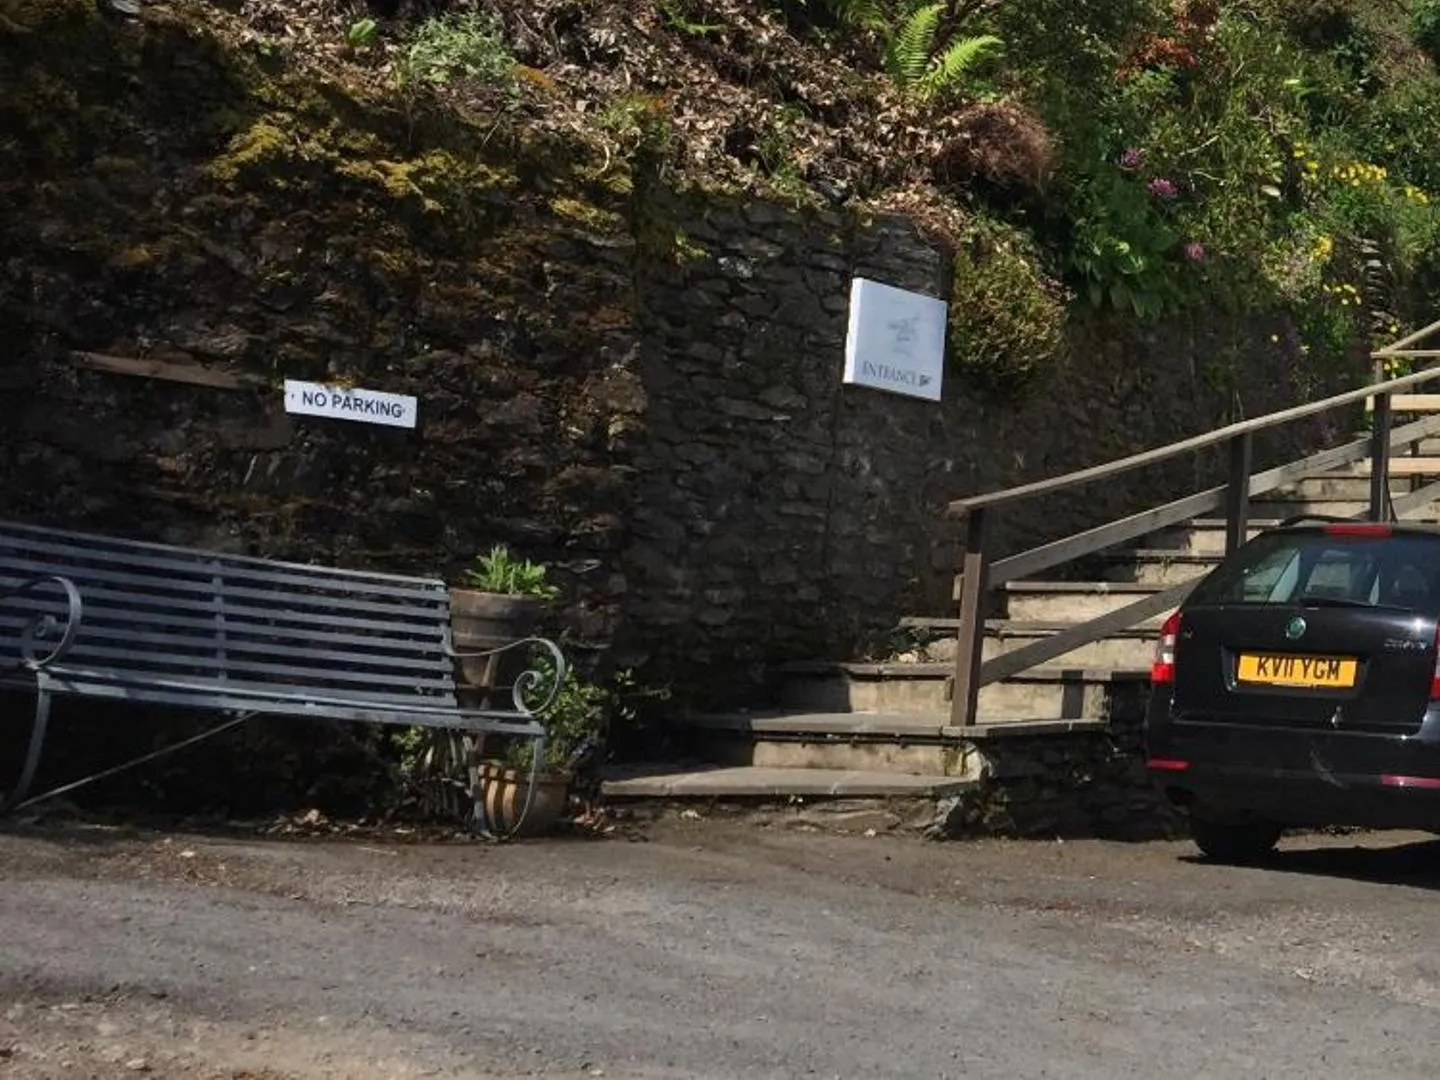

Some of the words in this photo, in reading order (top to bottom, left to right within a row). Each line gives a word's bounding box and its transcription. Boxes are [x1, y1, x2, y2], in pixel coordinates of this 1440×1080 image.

[301, 390, 327, 408] NO
[331, 393, 403, 418] PARKING
[1256, 655, 1295, 678] KV11
[1300, 657, 1341, 681] YGM
